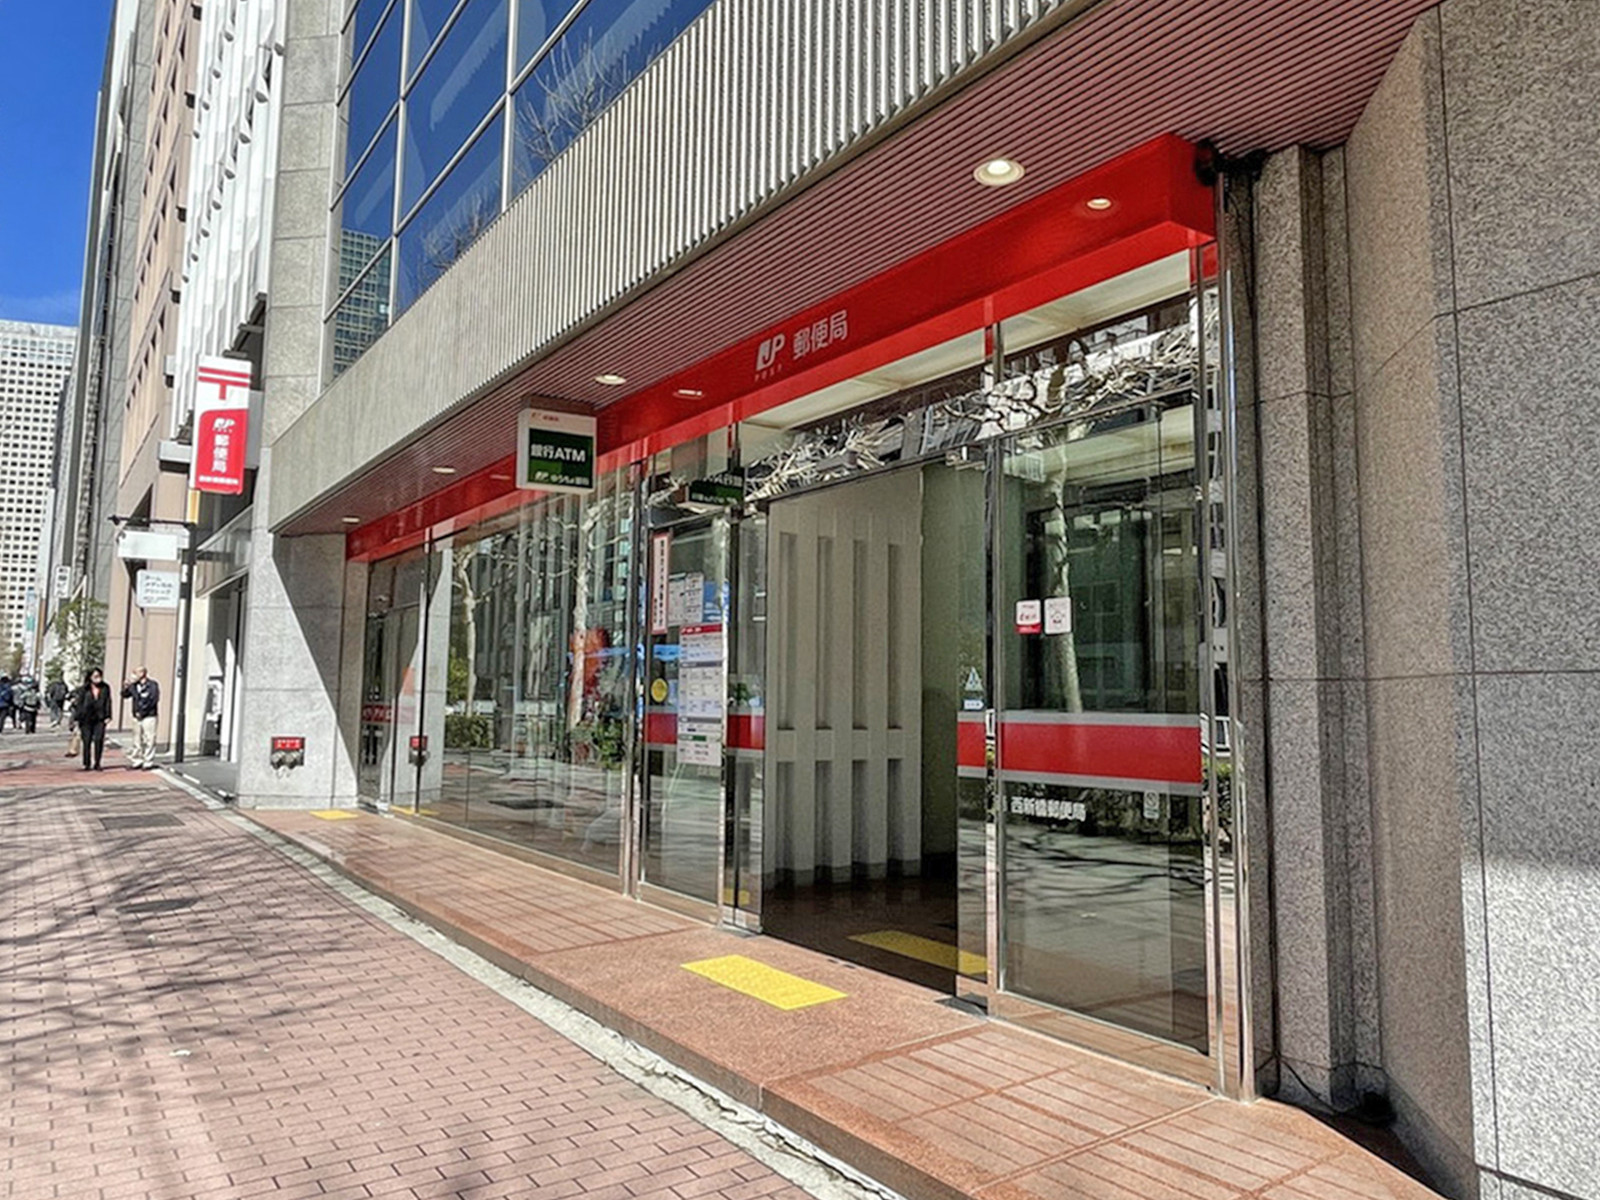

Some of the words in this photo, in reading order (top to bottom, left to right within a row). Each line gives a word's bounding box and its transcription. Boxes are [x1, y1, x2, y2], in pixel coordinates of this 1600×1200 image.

[793, 309, 848, 361] 郵便局
[211, 434, 230, 474] 郵便局
[530, 443, 587, 463] 銀行ATM
